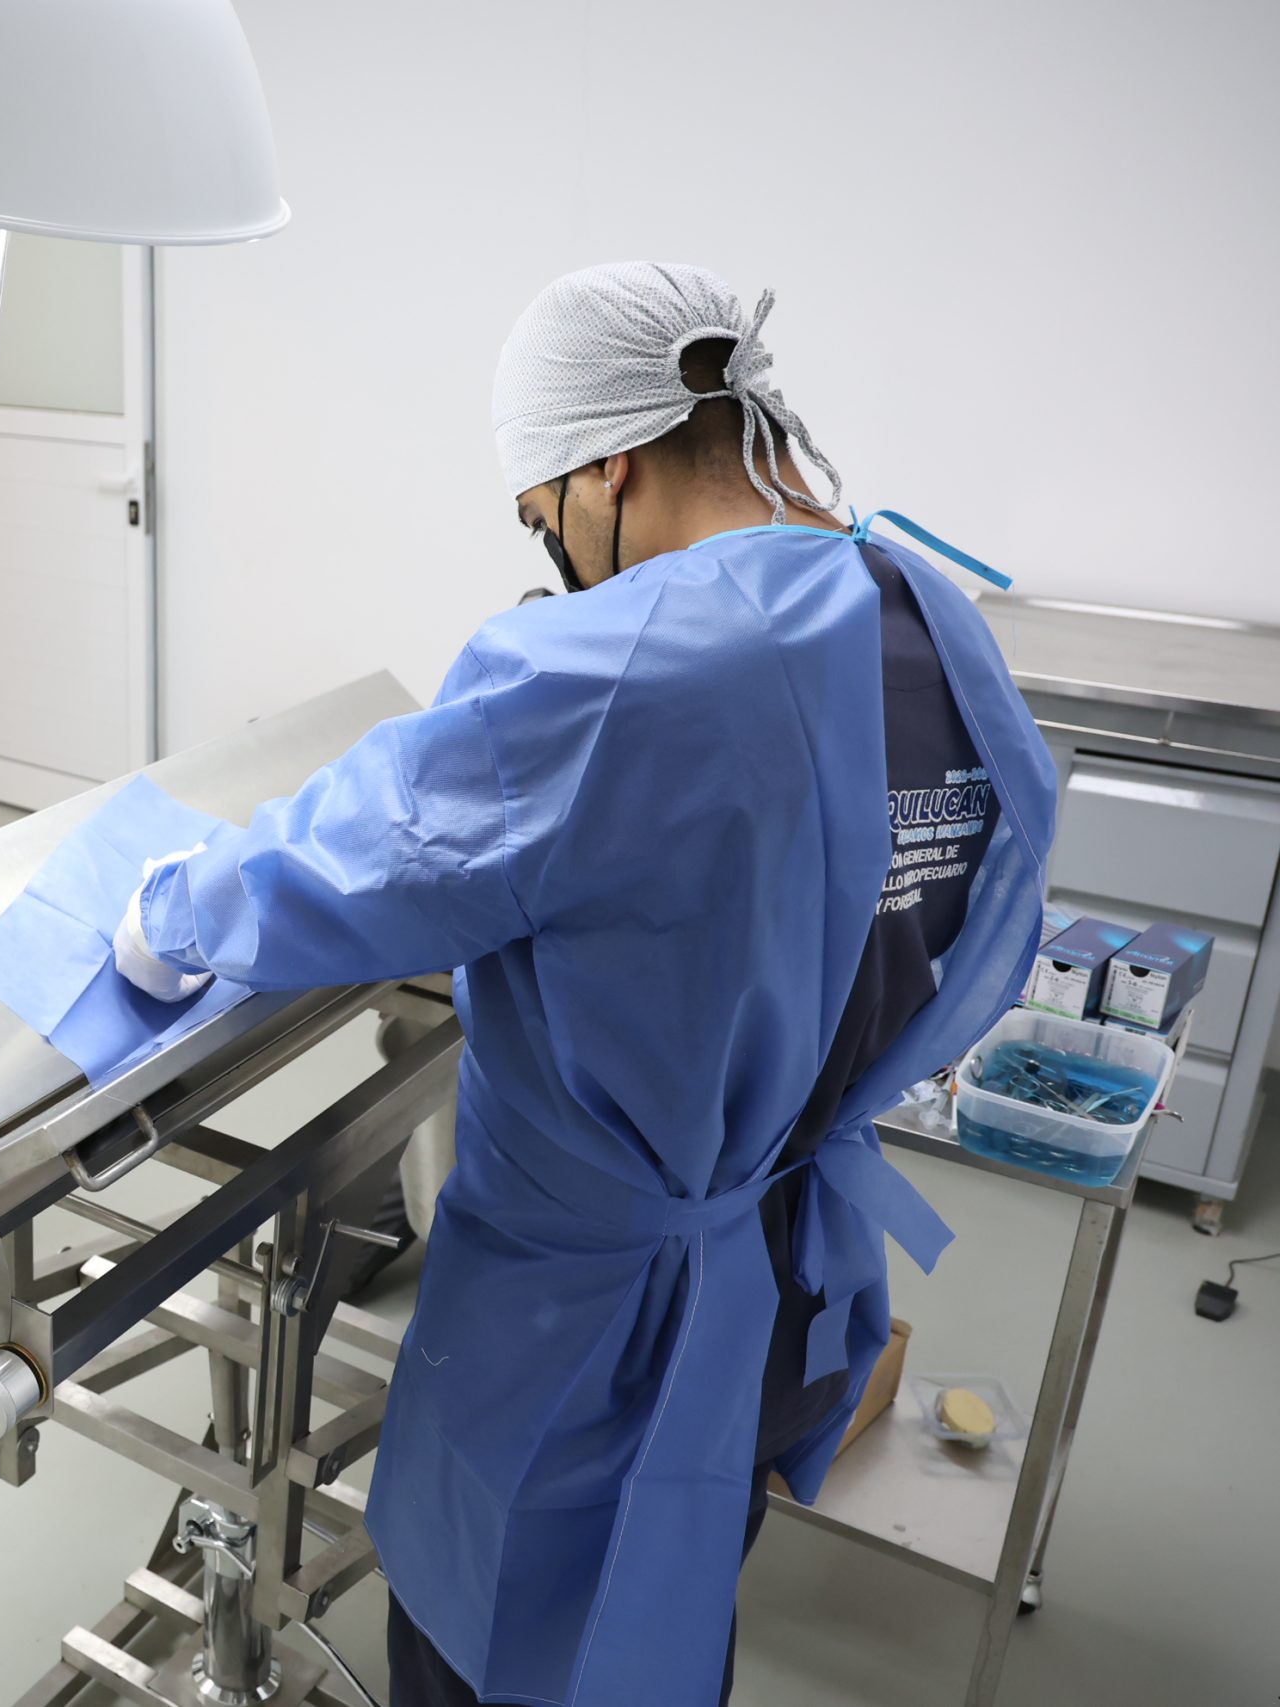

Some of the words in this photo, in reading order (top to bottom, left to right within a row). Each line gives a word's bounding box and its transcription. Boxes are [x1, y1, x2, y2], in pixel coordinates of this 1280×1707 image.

[888, 784, 991, 832] QUILUCAN
[888, 850, 904, 869] ÓN
[903, 847, 944, 866] GENERAL
[945, 845, 960, 859] DE
[882, 874, 904, 892] LLO
